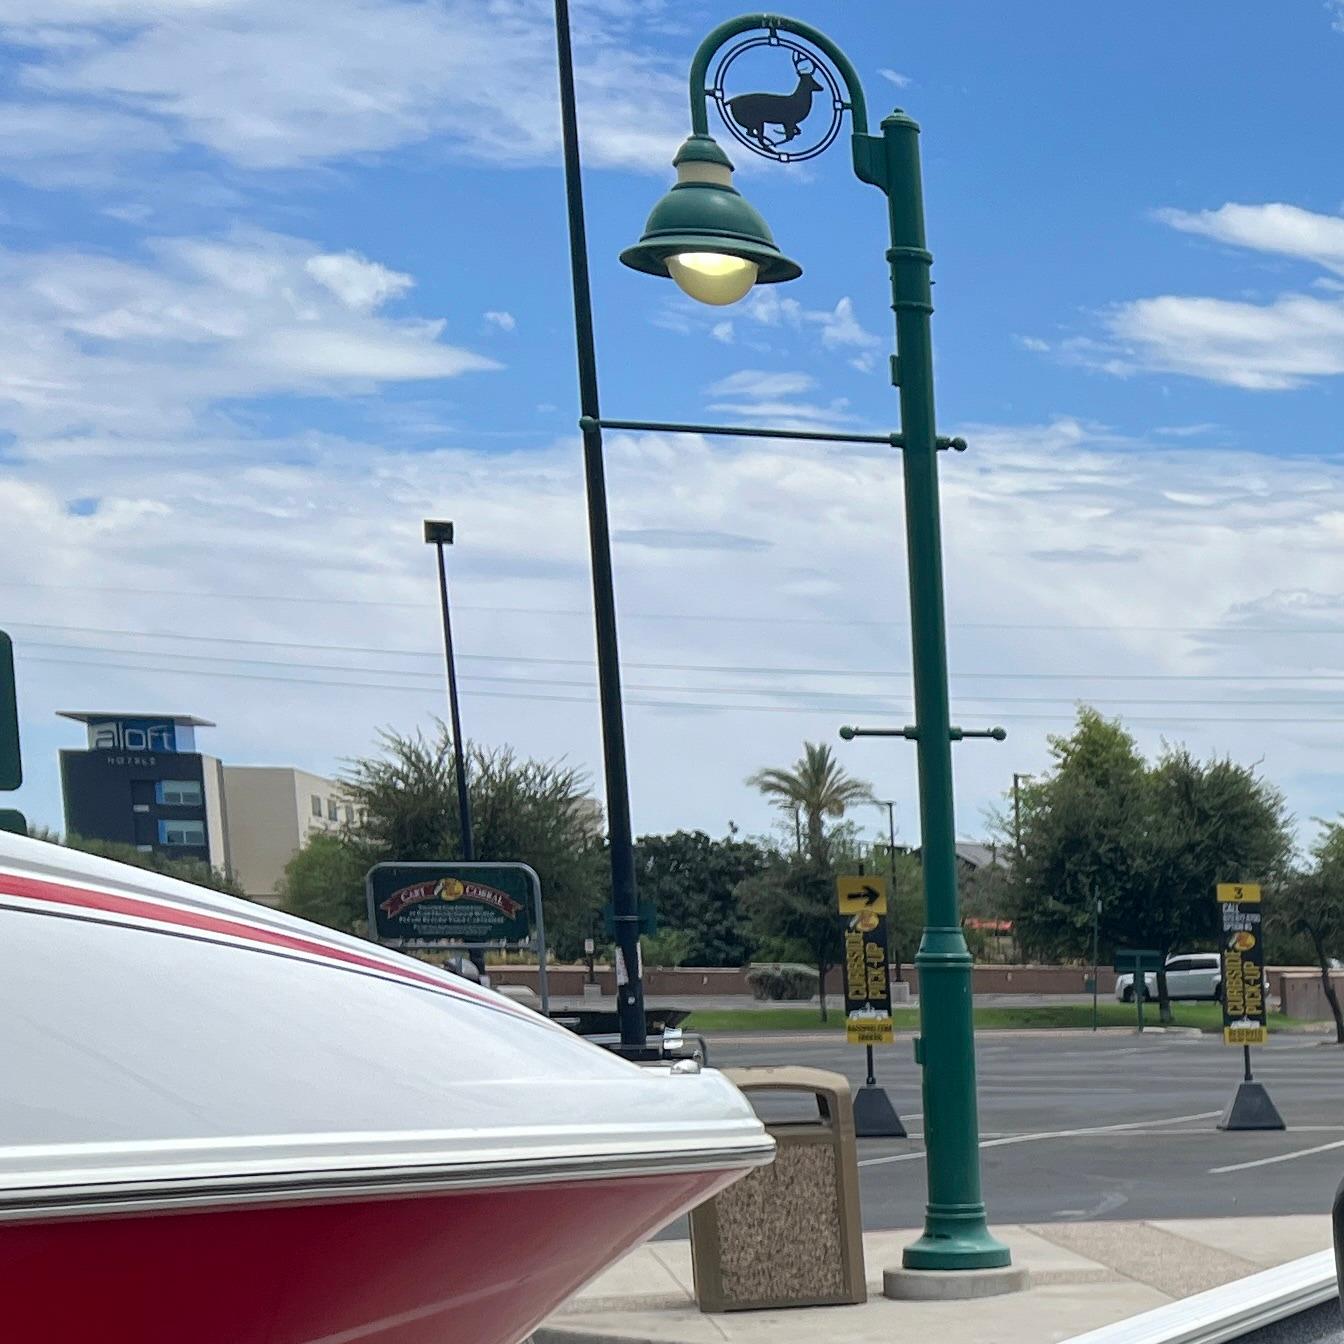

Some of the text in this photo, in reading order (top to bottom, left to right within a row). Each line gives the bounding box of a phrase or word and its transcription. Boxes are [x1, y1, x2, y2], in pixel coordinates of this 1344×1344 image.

[95, 721, 171, 750] aloft
[466, 885, 503, 904] CORRAL
[1234, 887, 1243, 899] 3
[845, 931, 867, 1000] CURBSIDE
[866, 942, 886, 1000] PICK-UP
[1225, 950, 1243, 1016] CURBSIDE
[1244, 961, 1262, 1015] PICK-UP
